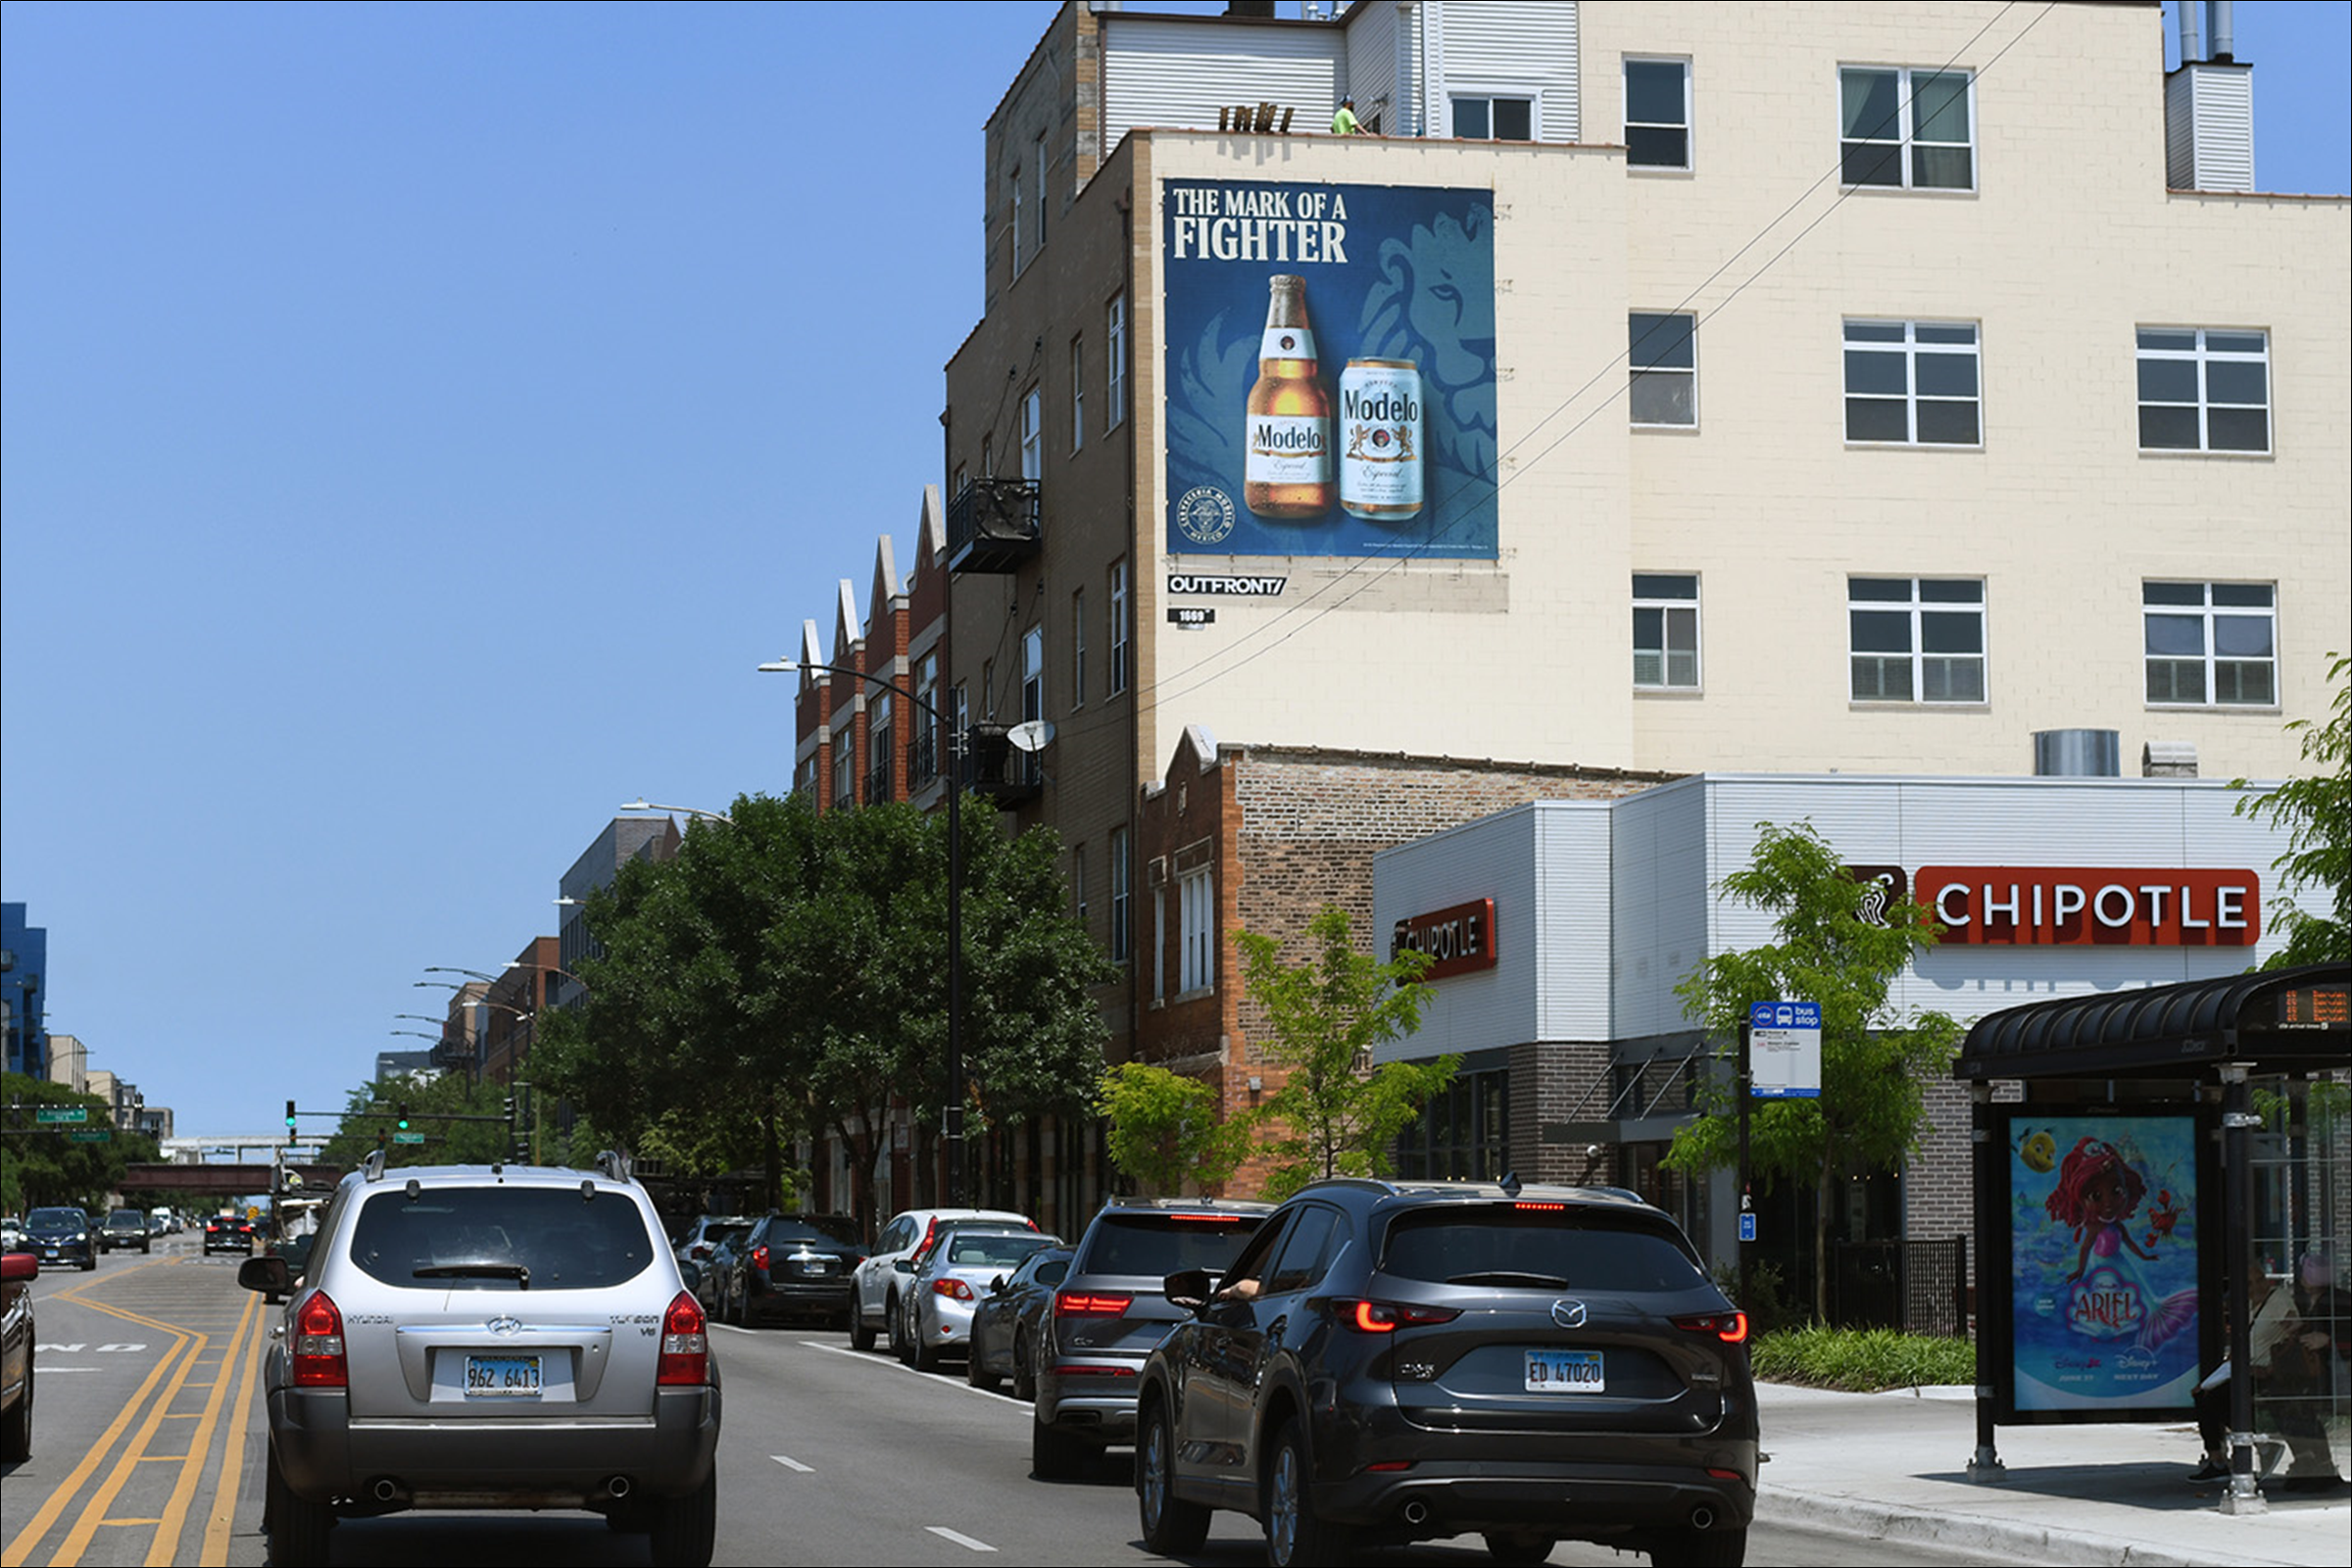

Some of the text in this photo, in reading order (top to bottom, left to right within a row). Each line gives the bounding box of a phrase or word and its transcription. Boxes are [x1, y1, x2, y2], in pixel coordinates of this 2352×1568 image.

[1173, 188, 1348, 220] THE MARK OF A
[1173, 217, 1348, 263] FIGHTER
[1345, 389, 1418, 421] Modelo
[1258, 423, 1321, 449] Modelo
[1936, 883, 2247, 928] CHIPOTLE
[1795, 1006, 1814, 1015] bus
[1795, 1016, 1818, 1026] stop
[2075, 1292, 2137, 1329] ARIEL
[640, 1327, 656, 1337] V6
[468, 1367, 540, 1389] 962 6413
[1530, 1362, 1600, 1383] ED 47020
